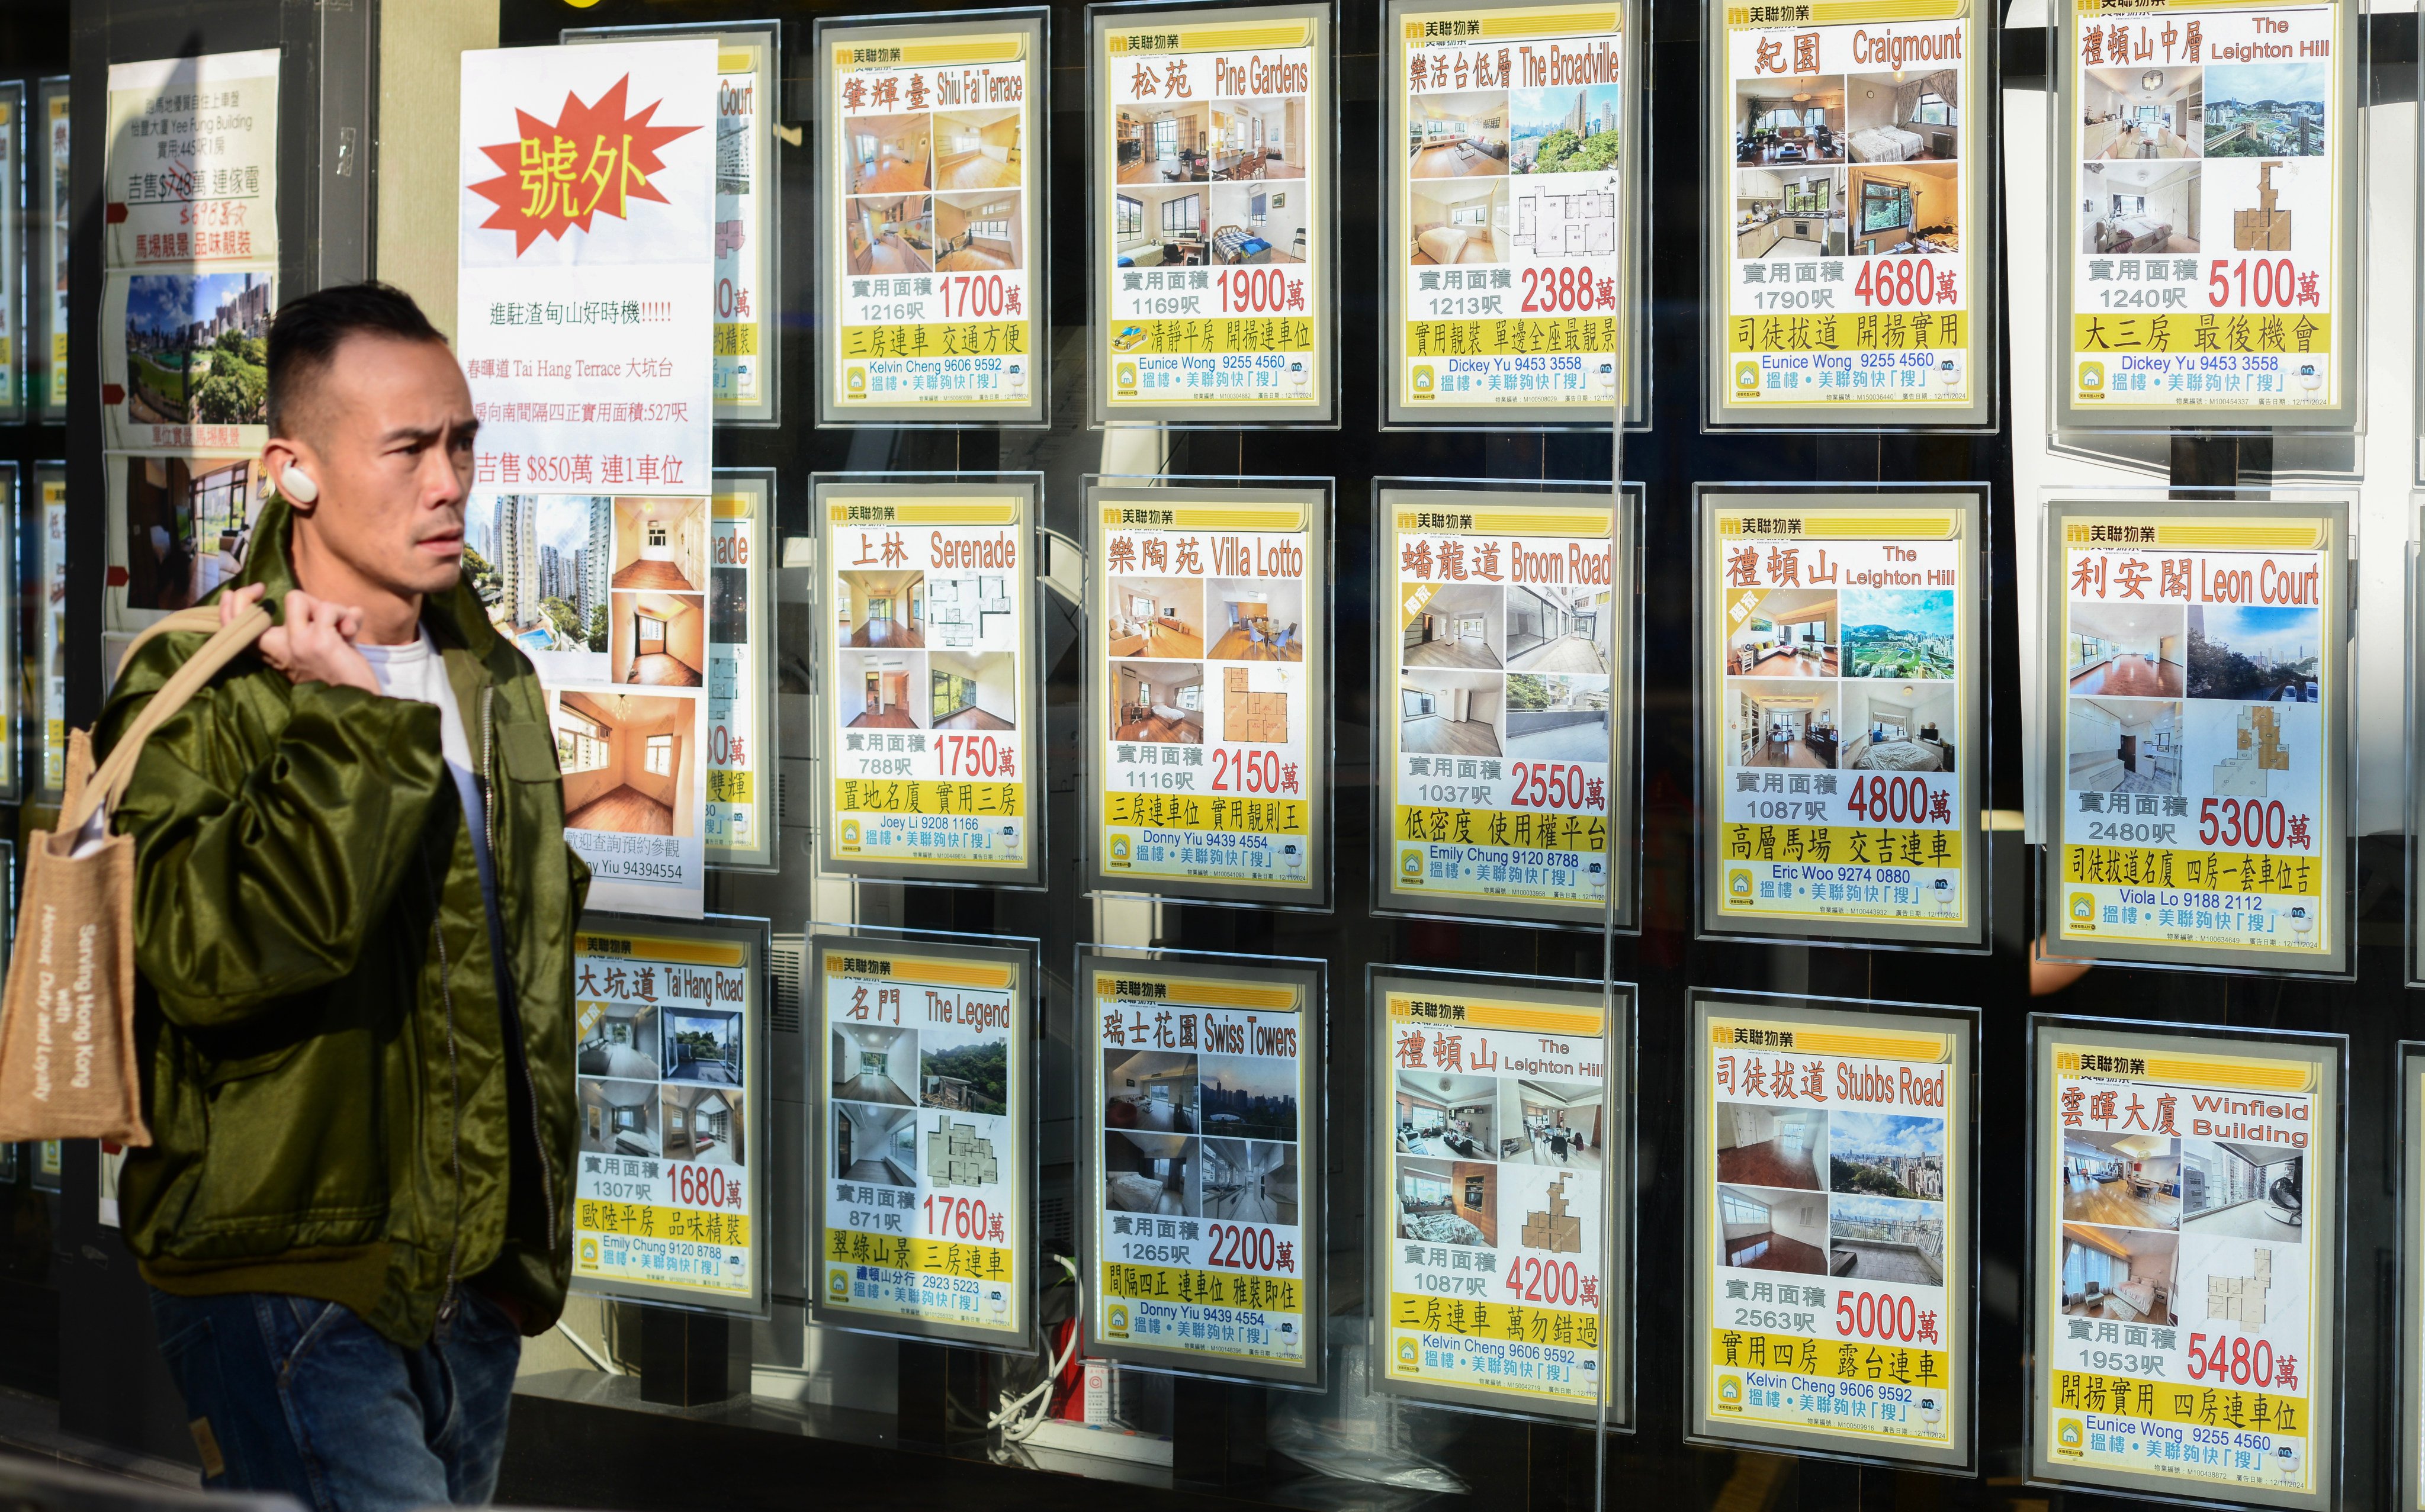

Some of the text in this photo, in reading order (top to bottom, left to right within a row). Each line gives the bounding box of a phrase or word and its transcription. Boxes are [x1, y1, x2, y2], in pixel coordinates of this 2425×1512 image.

[2252, 17, 2289, 34] The
[854, 47, 901, 63] 美聯物業
[1520, 42, 1618, 87] The Broadville
[1755, 33, 1820, 75] 紀園
[1854, 27, 1961, 70] Craigmount
[2212, 40, 2329, 63] Leighton Hill
[937, 69, 1022, 105] Shiu Fai Terrace
[1131, 60, 1192, 99] 松苑
[1216, 55, 1308, 95] Pine Gardens
[720, 79, 753, 115] Court
[842, 73, 930, 114] 肇輝臺
[171, 121, 188, 133] Yee
[190, 119, 213, 134] Fung
[217, 115, 252, 131] Building
[518, 133, 646, 219] 號外
[852, 278, 932, 298] 實用面積
[861, 302, 925, 320] 1216呎
[849, 324, 1023, 358] 三房連車 交通方便
[1151, 317, 1311, 353] 清靜平房 開揚連車位
[1737, 312, 1958, 351] 司徒拔道 開揚實用
[2083, 313, 2320, 353] 大三房 最後機會
[513, 360, 533, 376] Tai
[538, 360, 571, 379] Hang
[575, 360, 620, 376] Terrace
[625, 357, 673, 378] 大坑台
[870, 359, 1001, 374] Kelvin Cheng 9606 9592
[1139, 355, 1284, 371] Eunice Wong 9255 4560
[1450, 357, 1581, 374] Dickey Yu 9453 3558
[476, 452, 521, 484] 吉售
[852, 531, 908, 568] 上林
[931, 530, 1016, 568] Serenade
[1109, 536, 1204, 575] 樂陶苑
[1211, 536, 1303, 578] Villa Lotto
[1401, 540, 1504, 581] 蟠龍道
[1512, 542, 1611, 584] Broom Road
[1727, 546, 1838, 588] 禮頓山
[1883, 546, 1917, 562] The
[1846, 570, 1955, 588] Leighton Hill
[2071, 556, 2192, 602] 利安閣
[2202, 559, 2318, 605] Leon Court
[859, 758, 913, 776] 788呎
[881, 816, 978, 830] Joey Li 9208 1166
[1144, 831, 1268, 848] Donny Yiu 9439 4554
[1405, 808, 1605, 851] 低密度 使用權平台
[2089, 822, 2177, 845] 2480呎
[602, 860, 619, 874] Yiu
[624, 861, 682, 879] 94394554
[1430, 845, 1579, 867] Emily Chung 9120 8788
[1772, 865, 1910, 884] Eric Woo 9274 0880
[2119, 889, 2262, 911] Viola Lo 9188 2112
[577, 964, 659, 1003] 大坑道
[664, 967, 743, 1007] Tai Hang Road
[33, 904, 56, 1102] Honour Duty and Loyalty
[55, 988, 72, 1024] with
[70, 924, 97, 1089] Serving Hong Kong
[846, 985, 900, 1025] 名門
[925, 991, 1010, 1033] The Legend
[1103, 1010, 1198, 1050] 瑞士花園
[1205, 1014, 1296, 1057] Swiss Towers
[1538, 1039, 1569, 1054] The
[1395, 1030, 1498, 1073] 禮頓山
[1505, 1057, 1603, 1077] Leighton Hill
[1717, 1056, 1828, 1102] 司徒拔道
[1837, 1061, 1944, 1107] Stubbs Road
[2061, 1087, 2182, 1137] 雲暉大廈
[2192, 1095, 2308, 1121] Winfield
[2193, 1119, 2308, 1149] Building
[923, 1275, 949, 1290] 2923
[953, 1279, 979, 1294] 5223
[2080, 1349, 2166, 1377] 1953呎
[2061, 1374, 2297, 1432] 開揚實用 四房連車位
